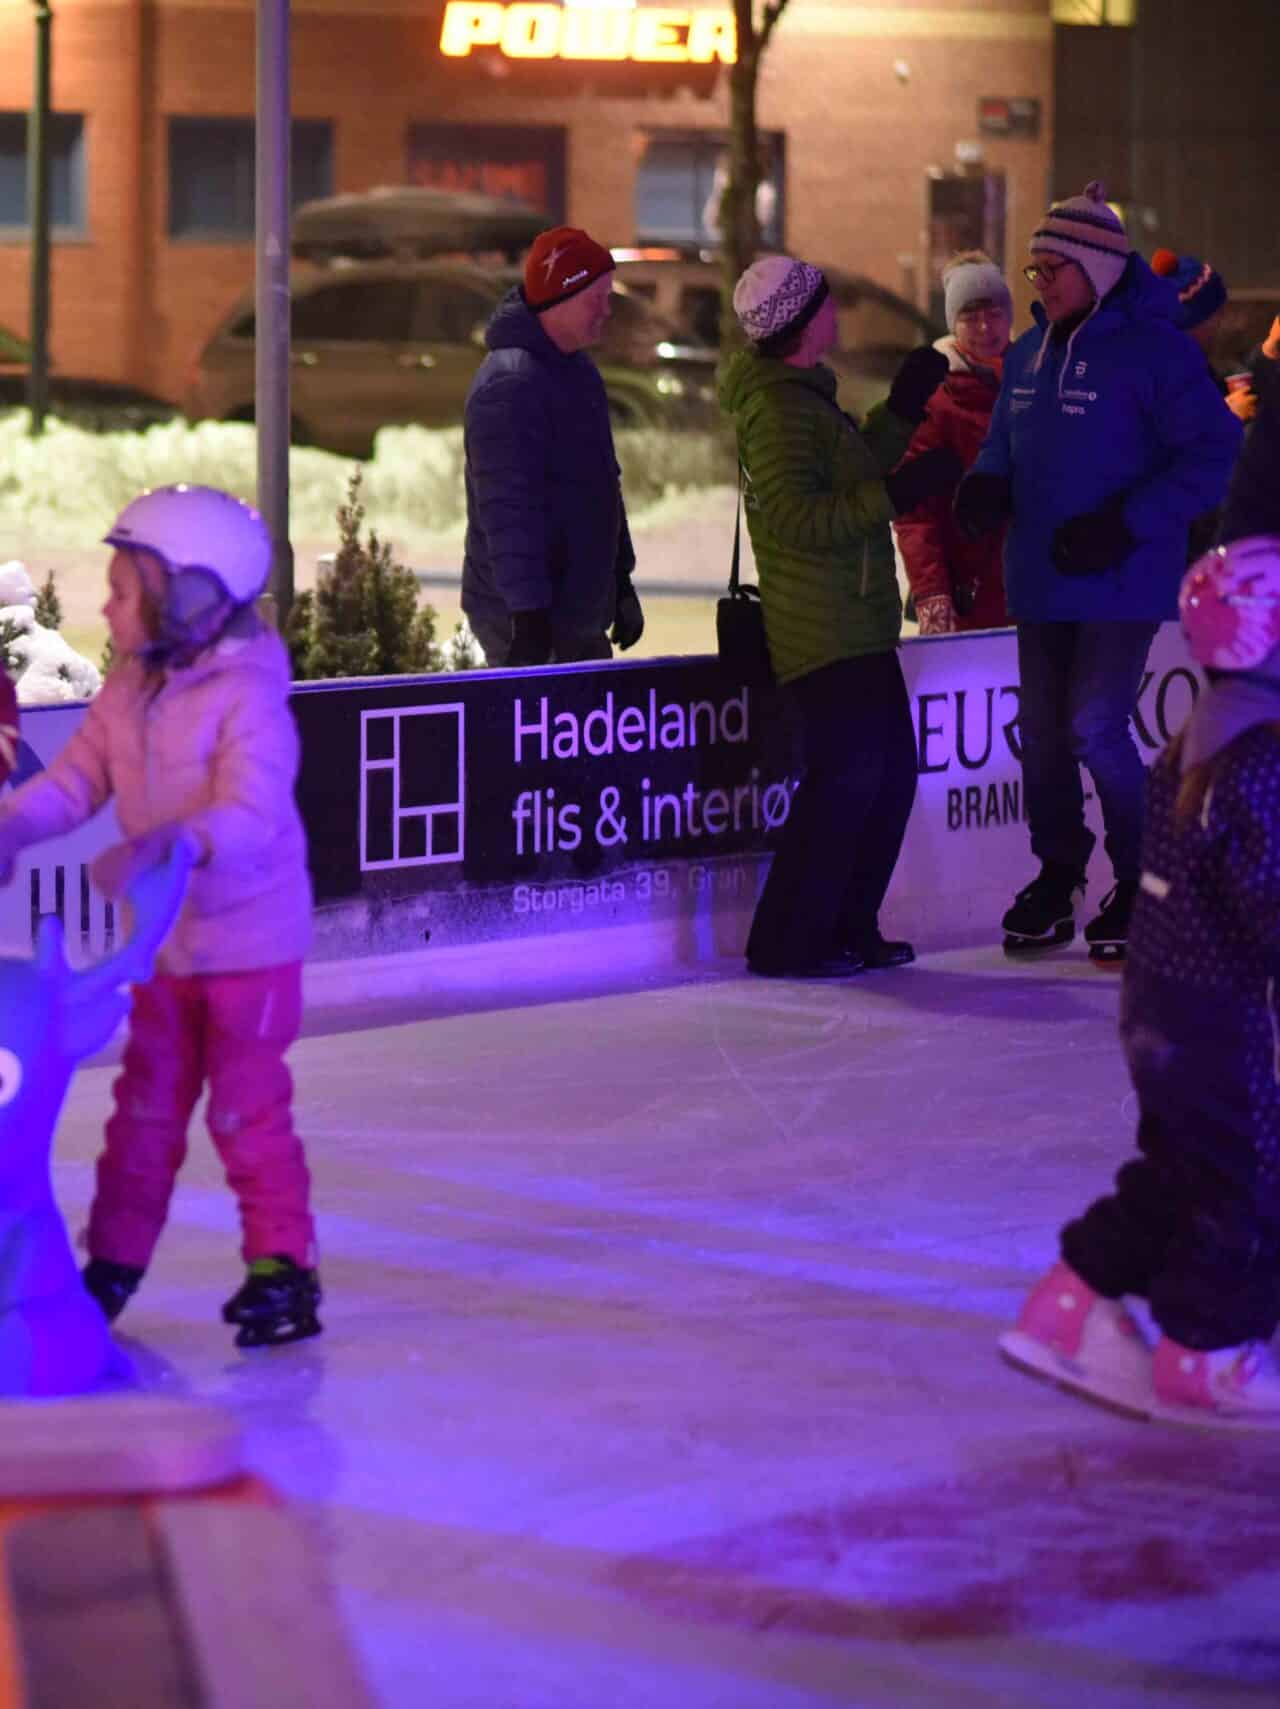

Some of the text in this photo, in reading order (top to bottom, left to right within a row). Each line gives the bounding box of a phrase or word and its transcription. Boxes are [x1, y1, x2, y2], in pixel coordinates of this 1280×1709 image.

[440, 1, 738, 64] POWER
[514, 687, 750, 763] Hadeland
[512, 767, 800, 855] flis & interiø
[946, 780, 1022, 831] BRAN
[513, 877, 626, 913] Storgata
